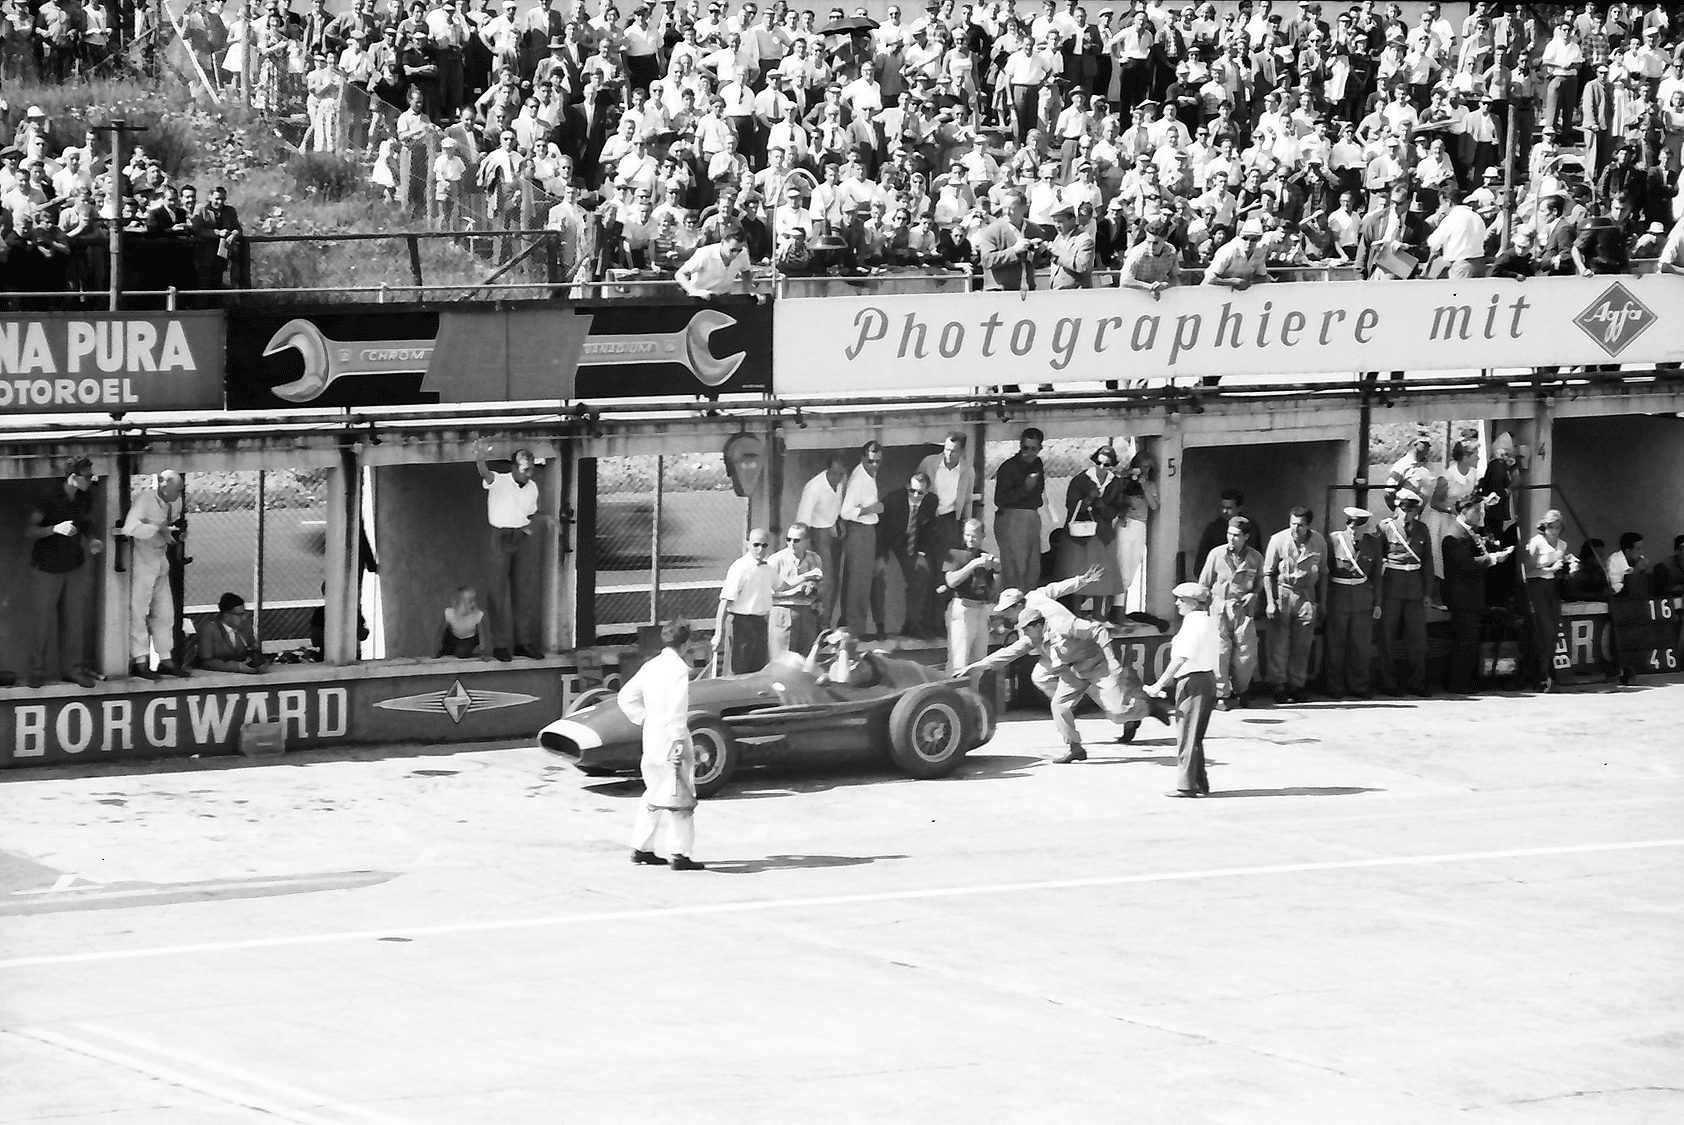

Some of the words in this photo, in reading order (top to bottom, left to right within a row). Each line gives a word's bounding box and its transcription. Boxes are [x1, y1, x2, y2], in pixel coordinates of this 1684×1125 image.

[67, 320, 196, 373] PURA
[844, 301, 1379, 371] Photographiere
[1429, 293, 1531, 341] mit
[1584, 301, 1643, 343] Agfa
[1168, 457, 1177, 478] 5
[1537, 442, 1546, 461] 4
[13, 687, 348, 758] BORGWARD
